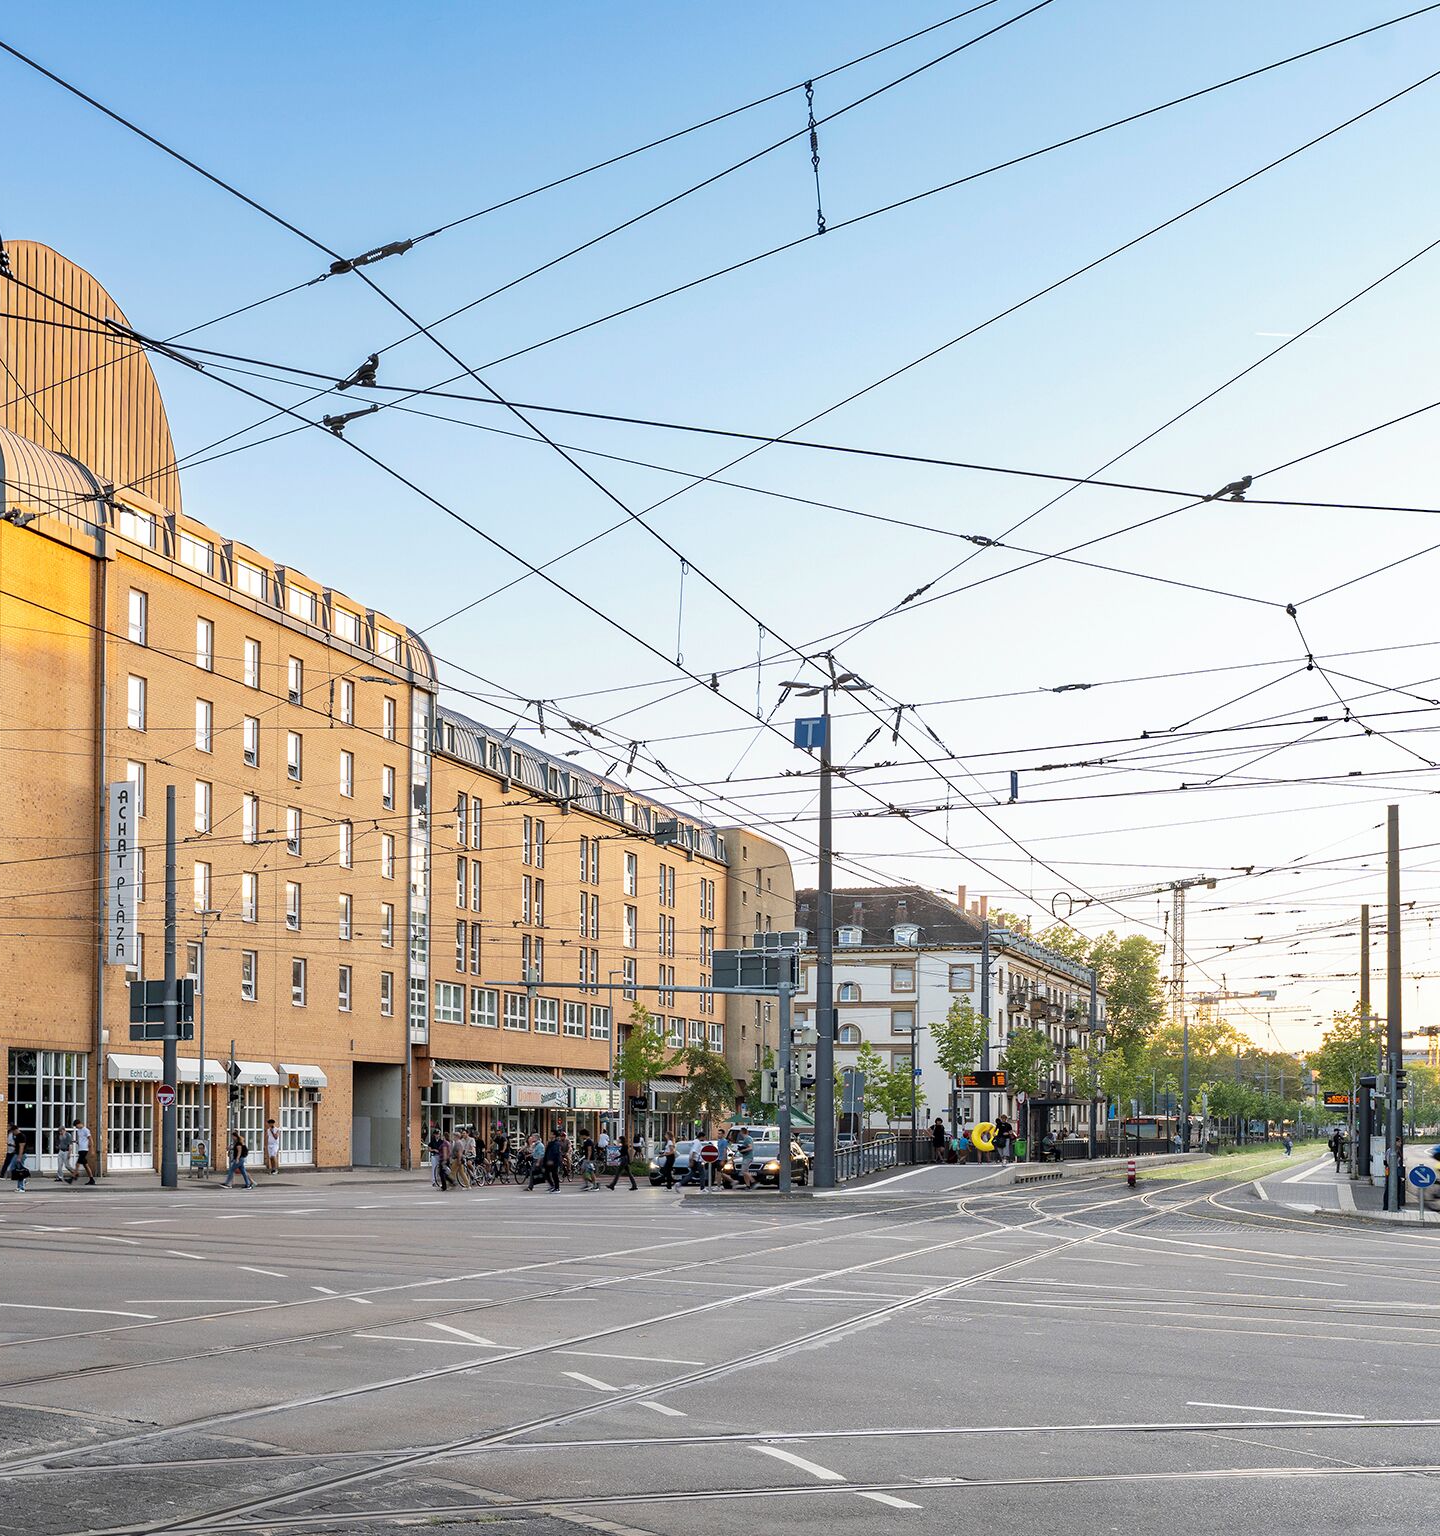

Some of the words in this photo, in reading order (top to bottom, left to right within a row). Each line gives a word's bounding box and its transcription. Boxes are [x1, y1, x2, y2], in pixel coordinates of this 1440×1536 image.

[801, 720, 820, 746] T
[117, 790, 129, 868] ACHAT
[116, 877, 126, 957] PLAZA
[130, 1069, 142, 1078] Echt
